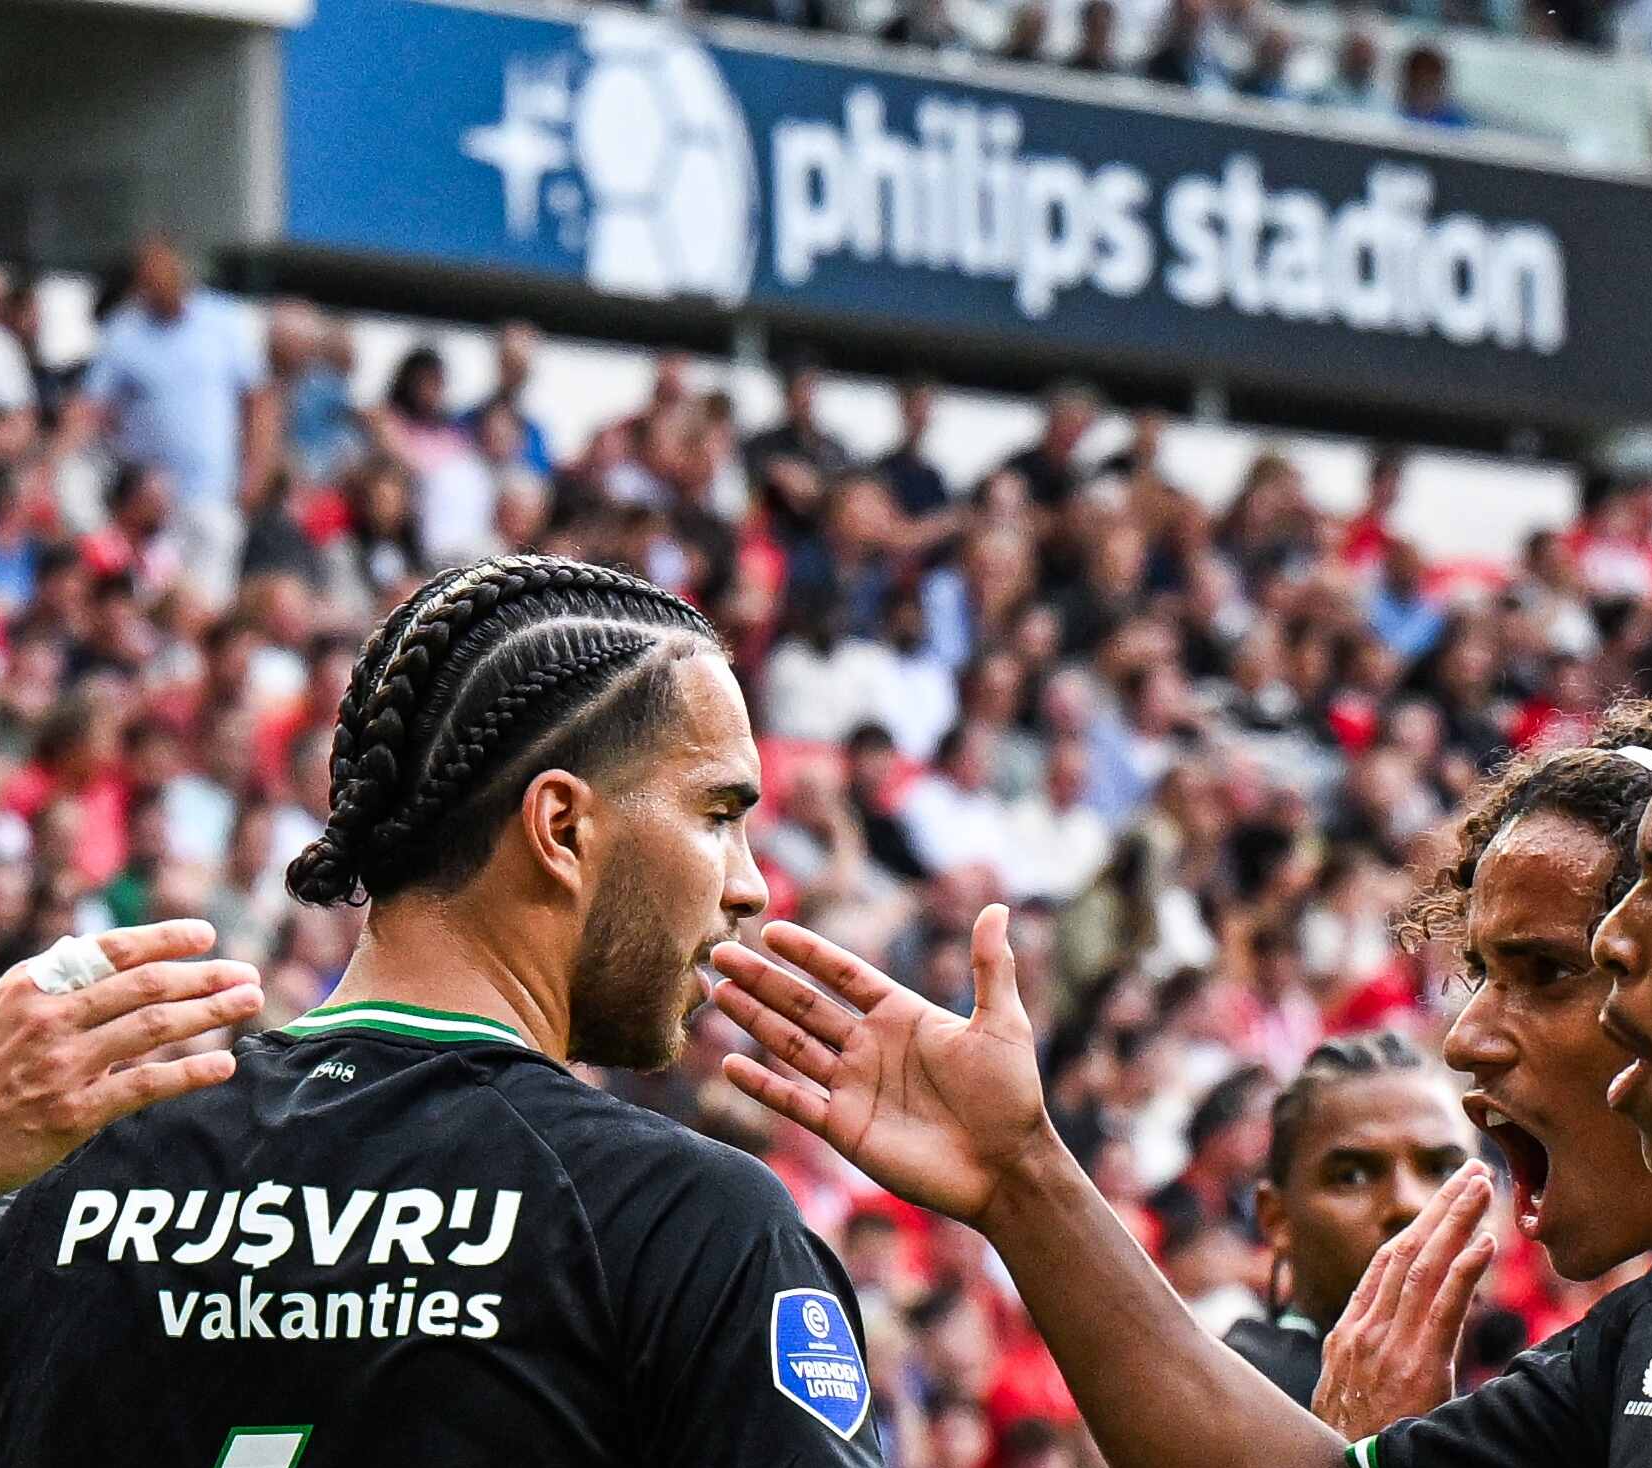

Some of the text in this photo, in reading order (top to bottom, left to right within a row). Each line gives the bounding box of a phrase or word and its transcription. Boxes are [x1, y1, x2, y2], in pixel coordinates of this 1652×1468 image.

[771, 87, 1568, 355] philips stadion
[159, 1274, 501, 1340] vakanties
